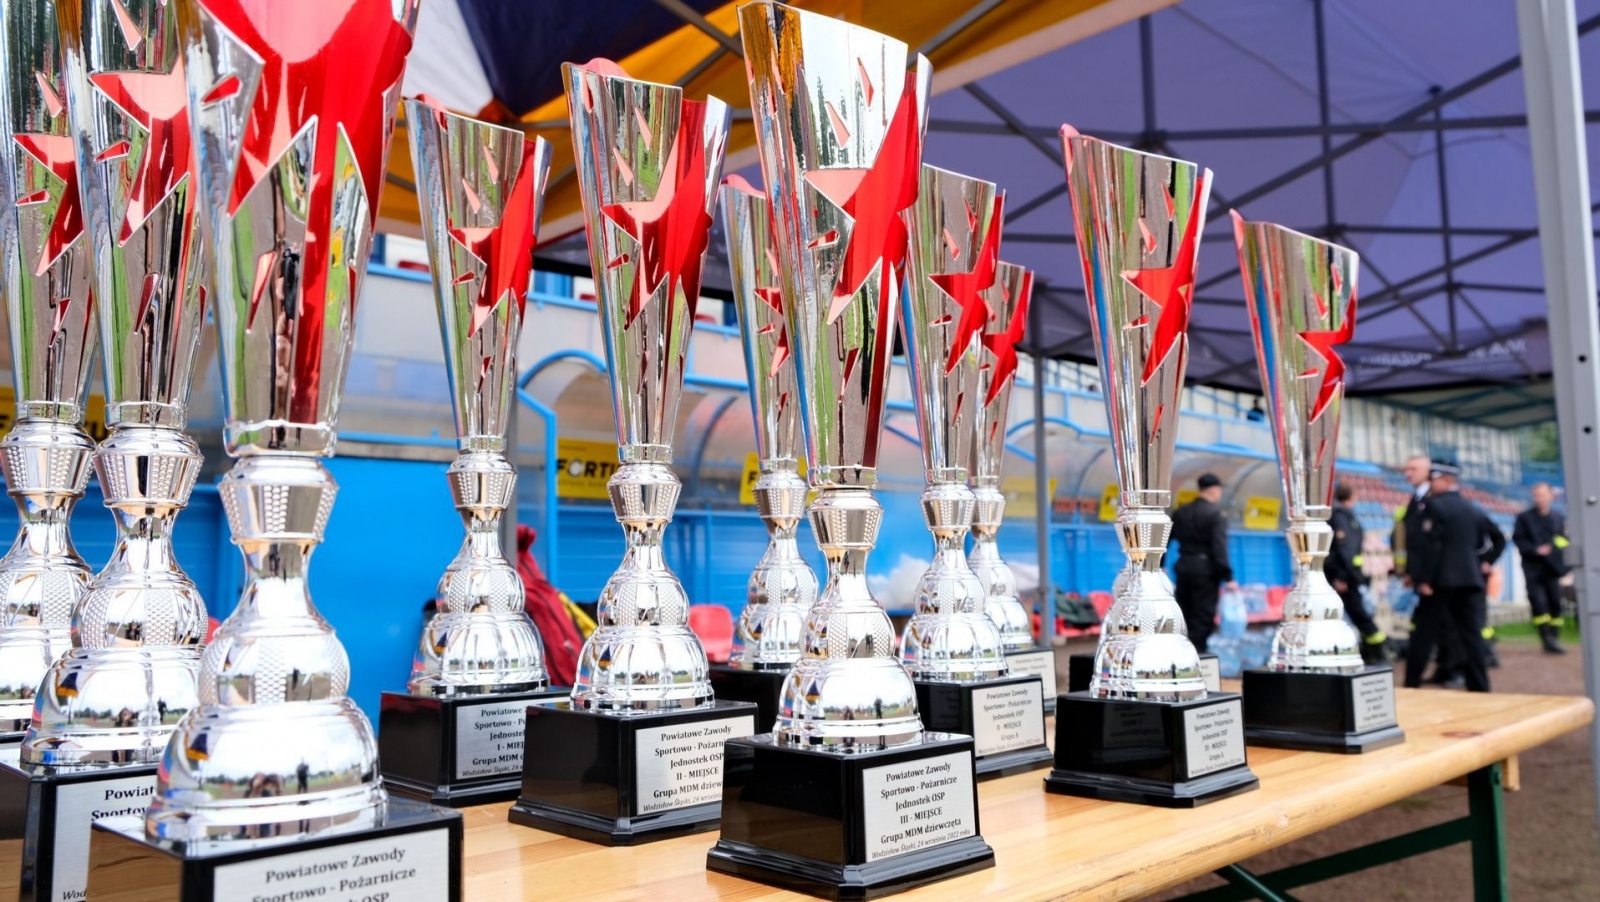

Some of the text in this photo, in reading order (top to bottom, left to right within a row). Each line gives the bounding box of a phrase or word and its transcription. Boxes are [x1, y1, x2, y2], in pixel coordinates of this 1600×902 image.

[481, 708, 522, 717] Powiatowe
[474, 721, 512, 731] Sportowo
[661, 725, 732, 741] Powiatowe Zawody
[490, 730, 525, 741] Jednoste
[507, 741, 524, 750] MIEJ
[655, 744, 692, 757] Sportowo
[698, 739, 725, 751] Pożarn
[472, 757, 497, 766] Grupa
[498, 754, 518, 763] MDM
[670, 752, 724, 769] Jednostek OSP
[676, 772, 682, 780] II
[689, 766, 720, 779] MIEJSCE
[886, 762, 951, 782] Powiatowe Zawody
[104, 786, 154, 800] Powiat
[653, 780, 722, 798] Grupa MDM dziew
[880, 785, 915, 799] Sportowo
[920, 775, 957, 790] Pożarnicze
[895, 792, 945, 812] Jednostek OSP
[900, 815, 908, 824] III
[914, 807, 943, 821] MIEJSCE
[880, 818, 961, 844] Grupa MDM dziewczęta
[265, 848, 406, 884] Powiatowe Zawody
[339, 868, 416, 891] Pożarnicze
[361, 892, 390, 902] OSP
